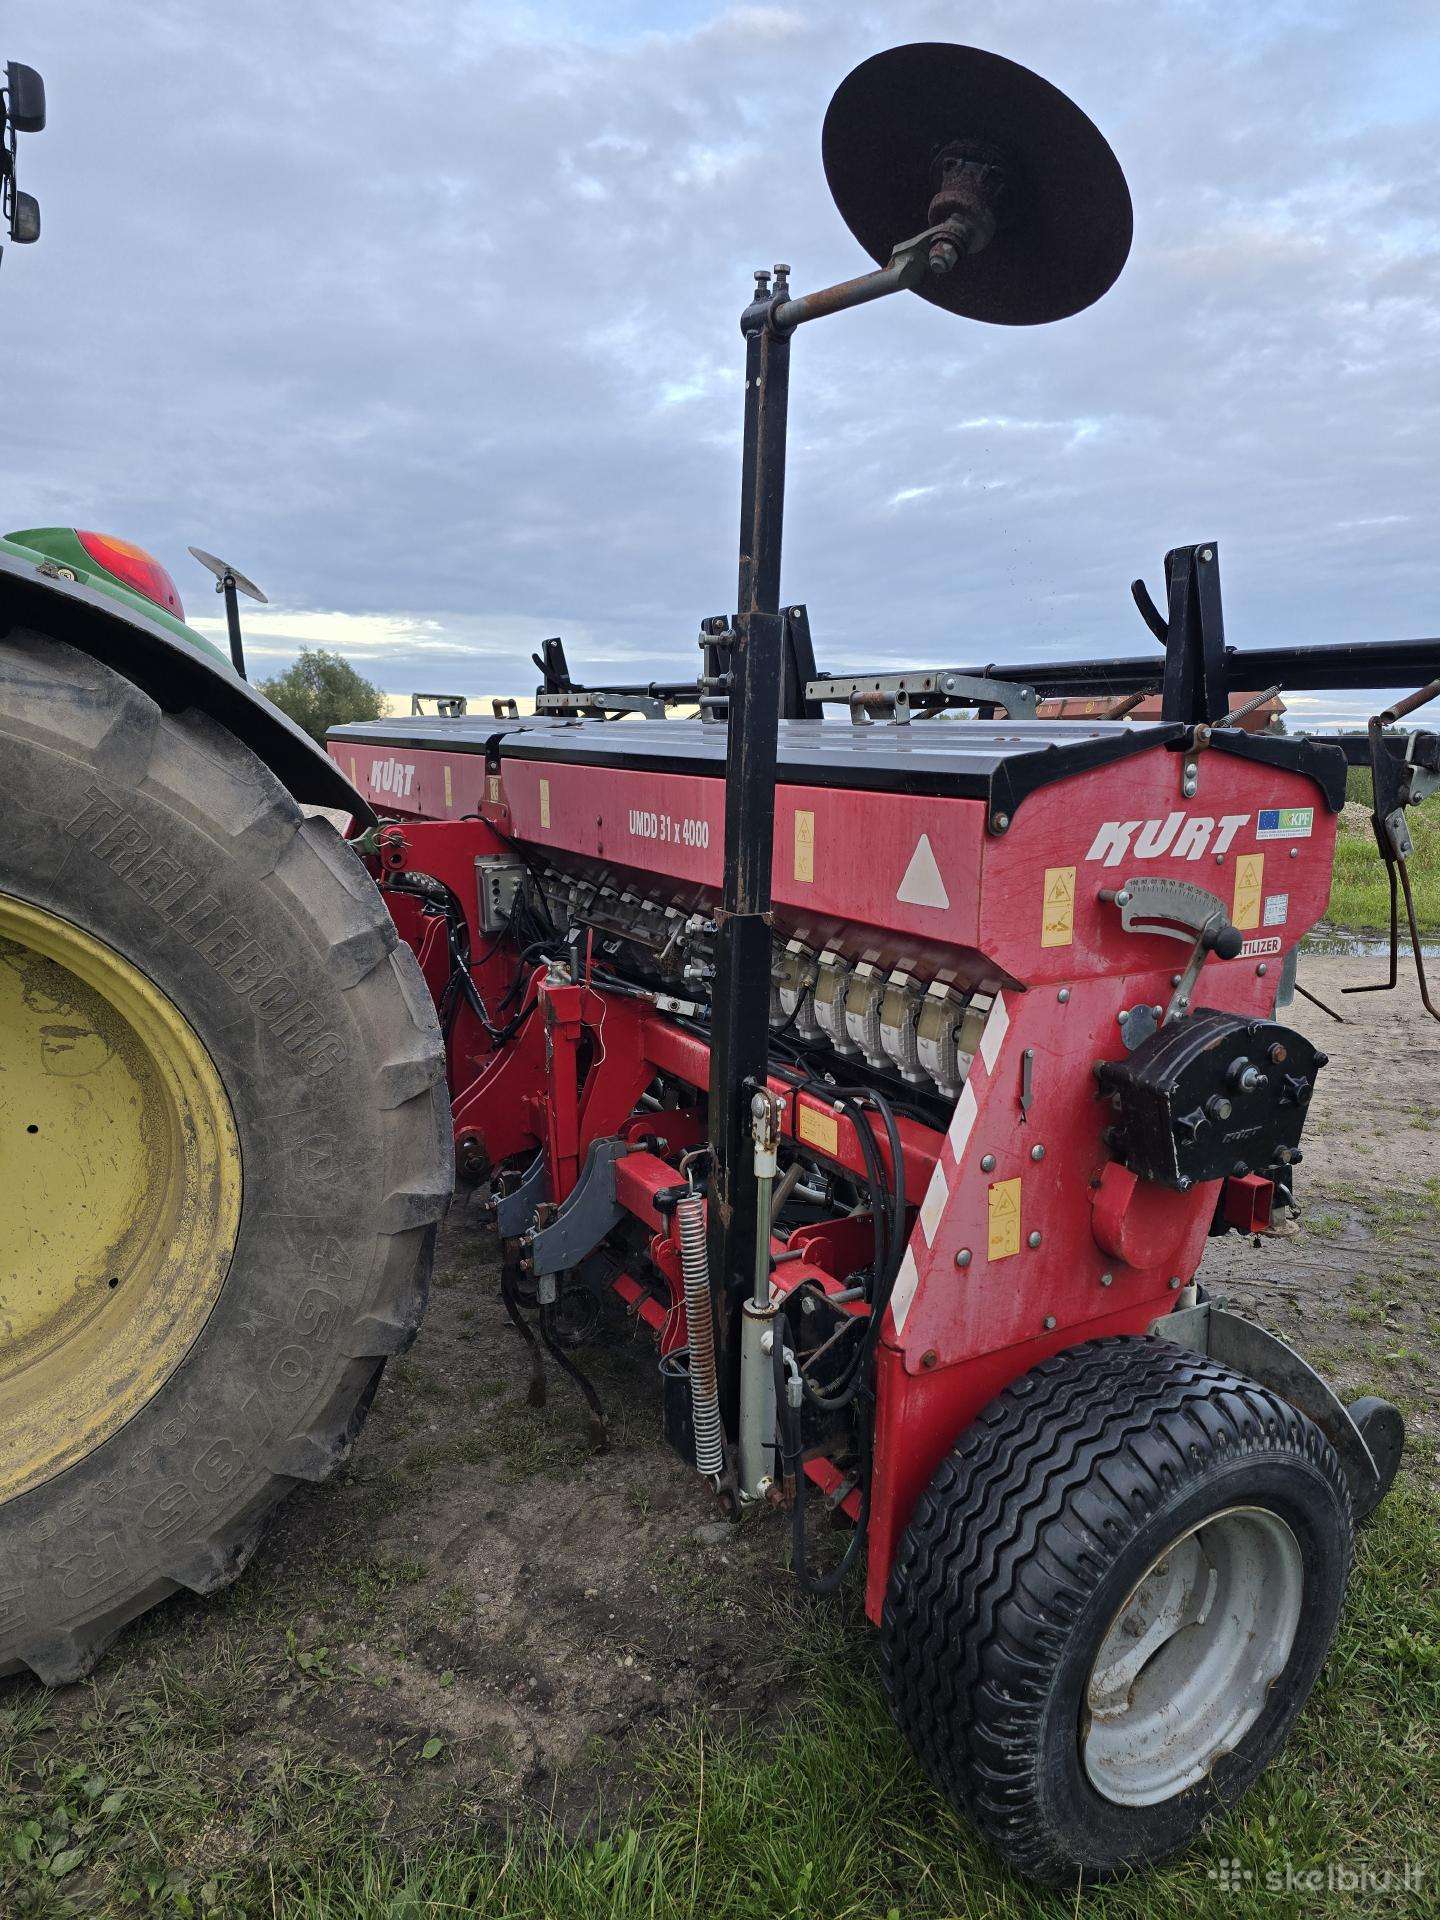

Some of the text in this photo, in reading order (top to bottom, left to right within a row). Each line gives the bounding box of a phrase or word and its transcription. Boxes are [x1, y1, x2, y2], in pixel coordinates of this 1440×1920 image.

[371, 758, 416, 798] KURT
[629, 810, 657, 839] UMDD
[660, 814, 671, 842] 31
[683, 818, 709, 849] 4000
[1290, 812, 1311, 826] KPF
[1085, 811, 1251, 867] KURT
[65, 785, 346, 1076] TRELLEBORG
[1243, 939, 1278, 955] TILIZER
